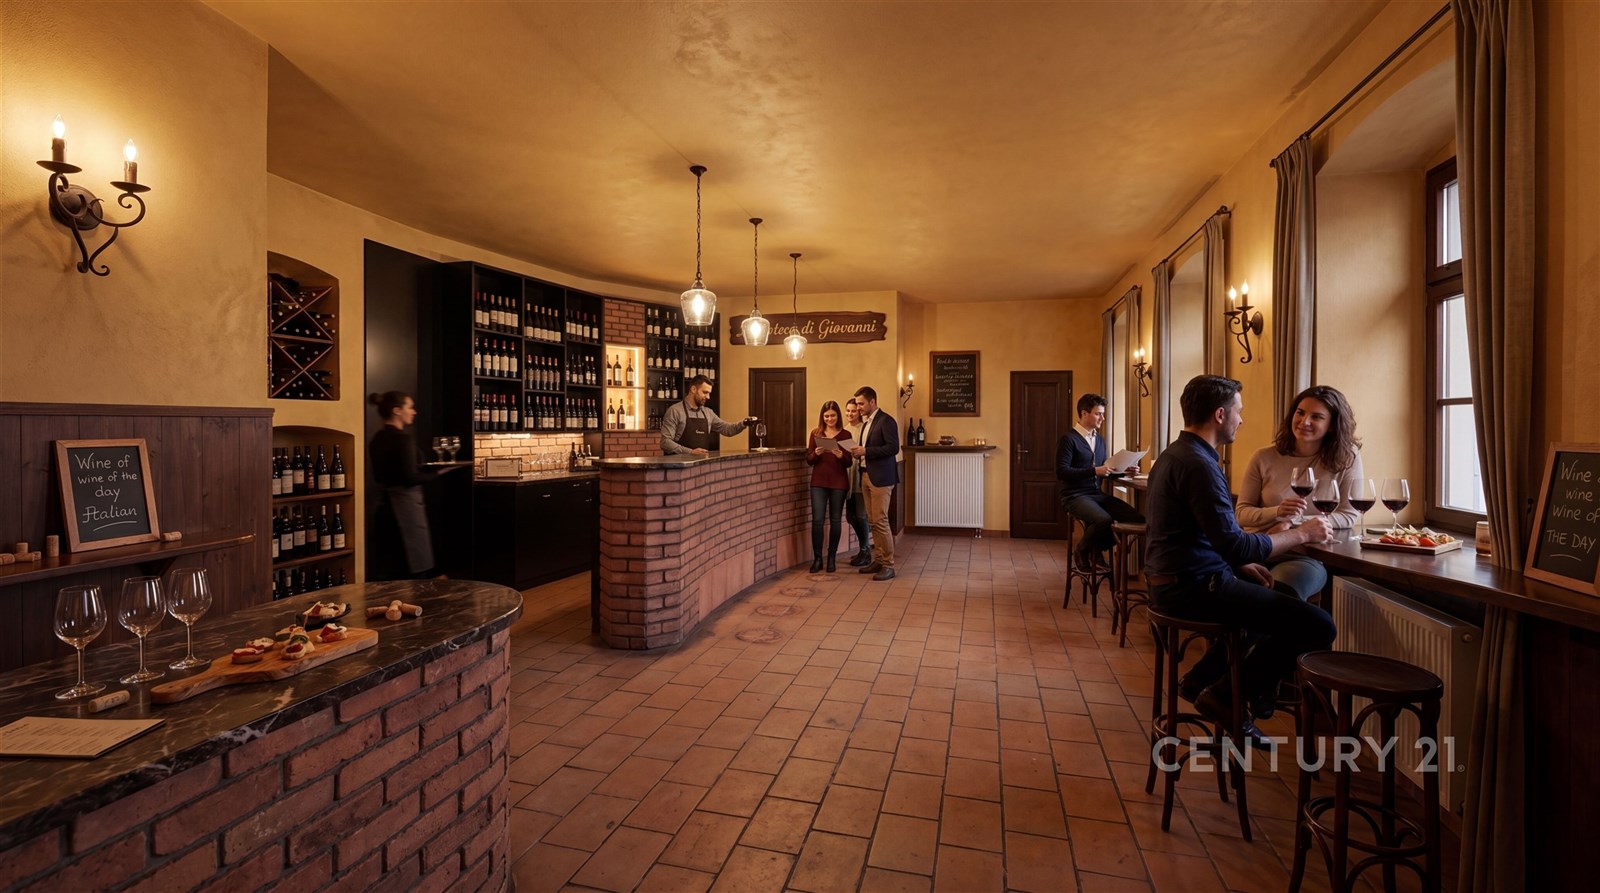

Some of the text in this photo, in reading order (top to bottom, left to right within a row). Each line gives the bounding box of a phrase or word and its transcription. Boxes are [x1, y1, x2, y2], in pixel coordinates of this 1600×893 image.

[801, 320, 814, 334] di
[818, 319, 876, 340] Giovanni
[75, 453, 130, 469] Wine of
[78, 470, 138, 484] wine of the
[1561, 459, 1592, 483] Wine
[95, 485, 121, 503] day
[1566, 487, 1593, 502] wine
[1552, 504, 1581, 521] Wine
[1546, 529, 1597, 554] THE DAY
